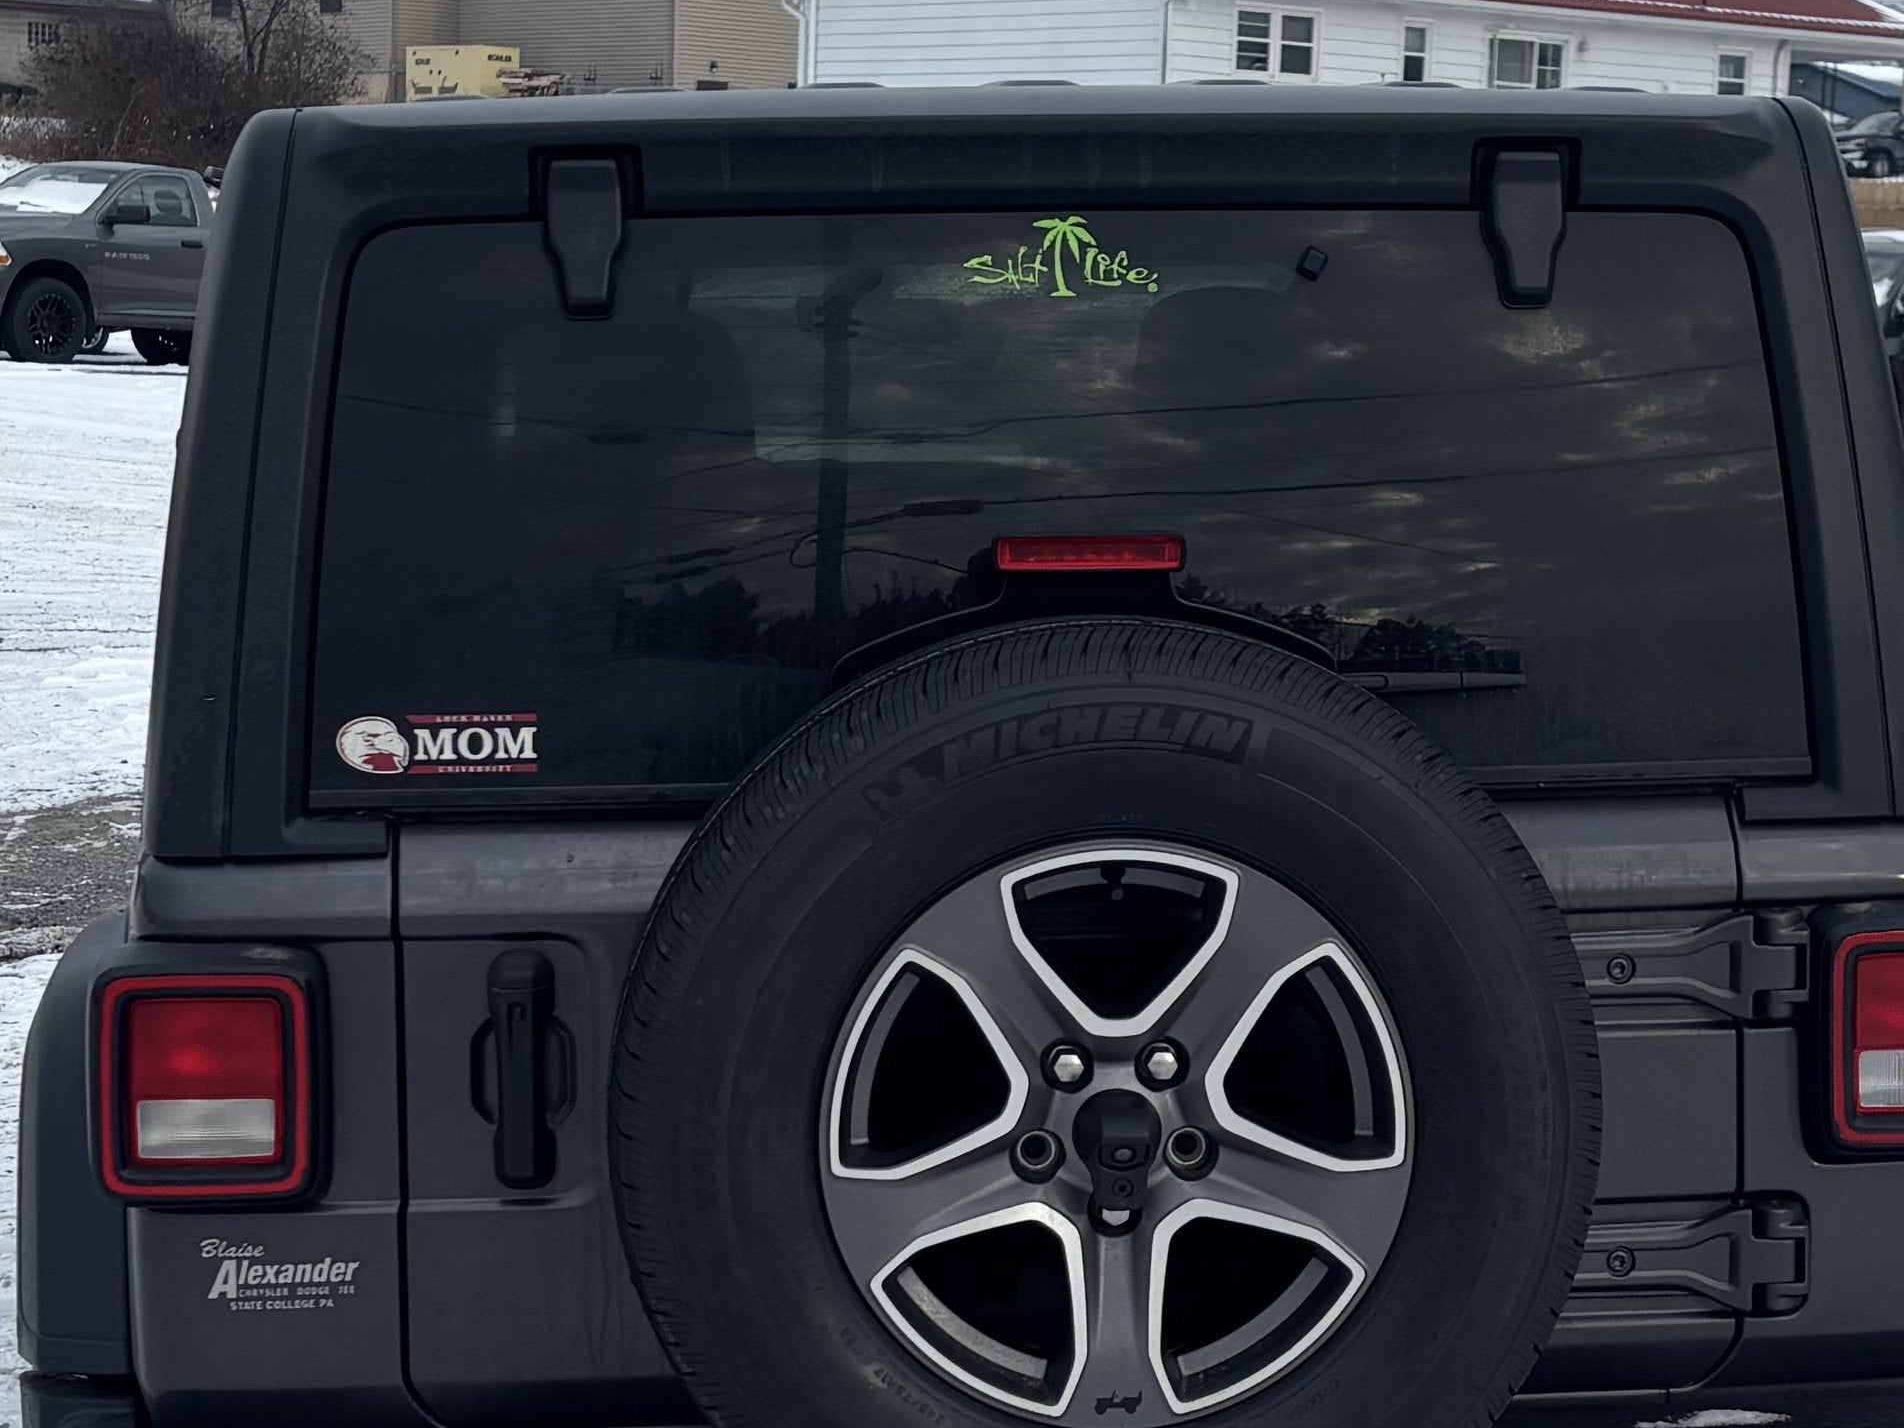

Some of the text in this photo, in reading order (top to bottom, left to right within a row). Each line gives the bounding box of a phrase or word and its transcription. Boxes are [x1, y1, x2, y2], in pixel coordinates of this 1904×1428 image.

[413, 726, 538, 761] MOM
[943, 704, 1250, 782] MICHELIN
[200, 1238, 266, 1259] Blaise
[207, 1257, 361, 1300] Alexander
[238, 1286, 289, 1298] CHRYSLER
[296, 1285, 330, 1296] DODGE
[229, 1298, 335, 1311] STATE COLLEGE PA
